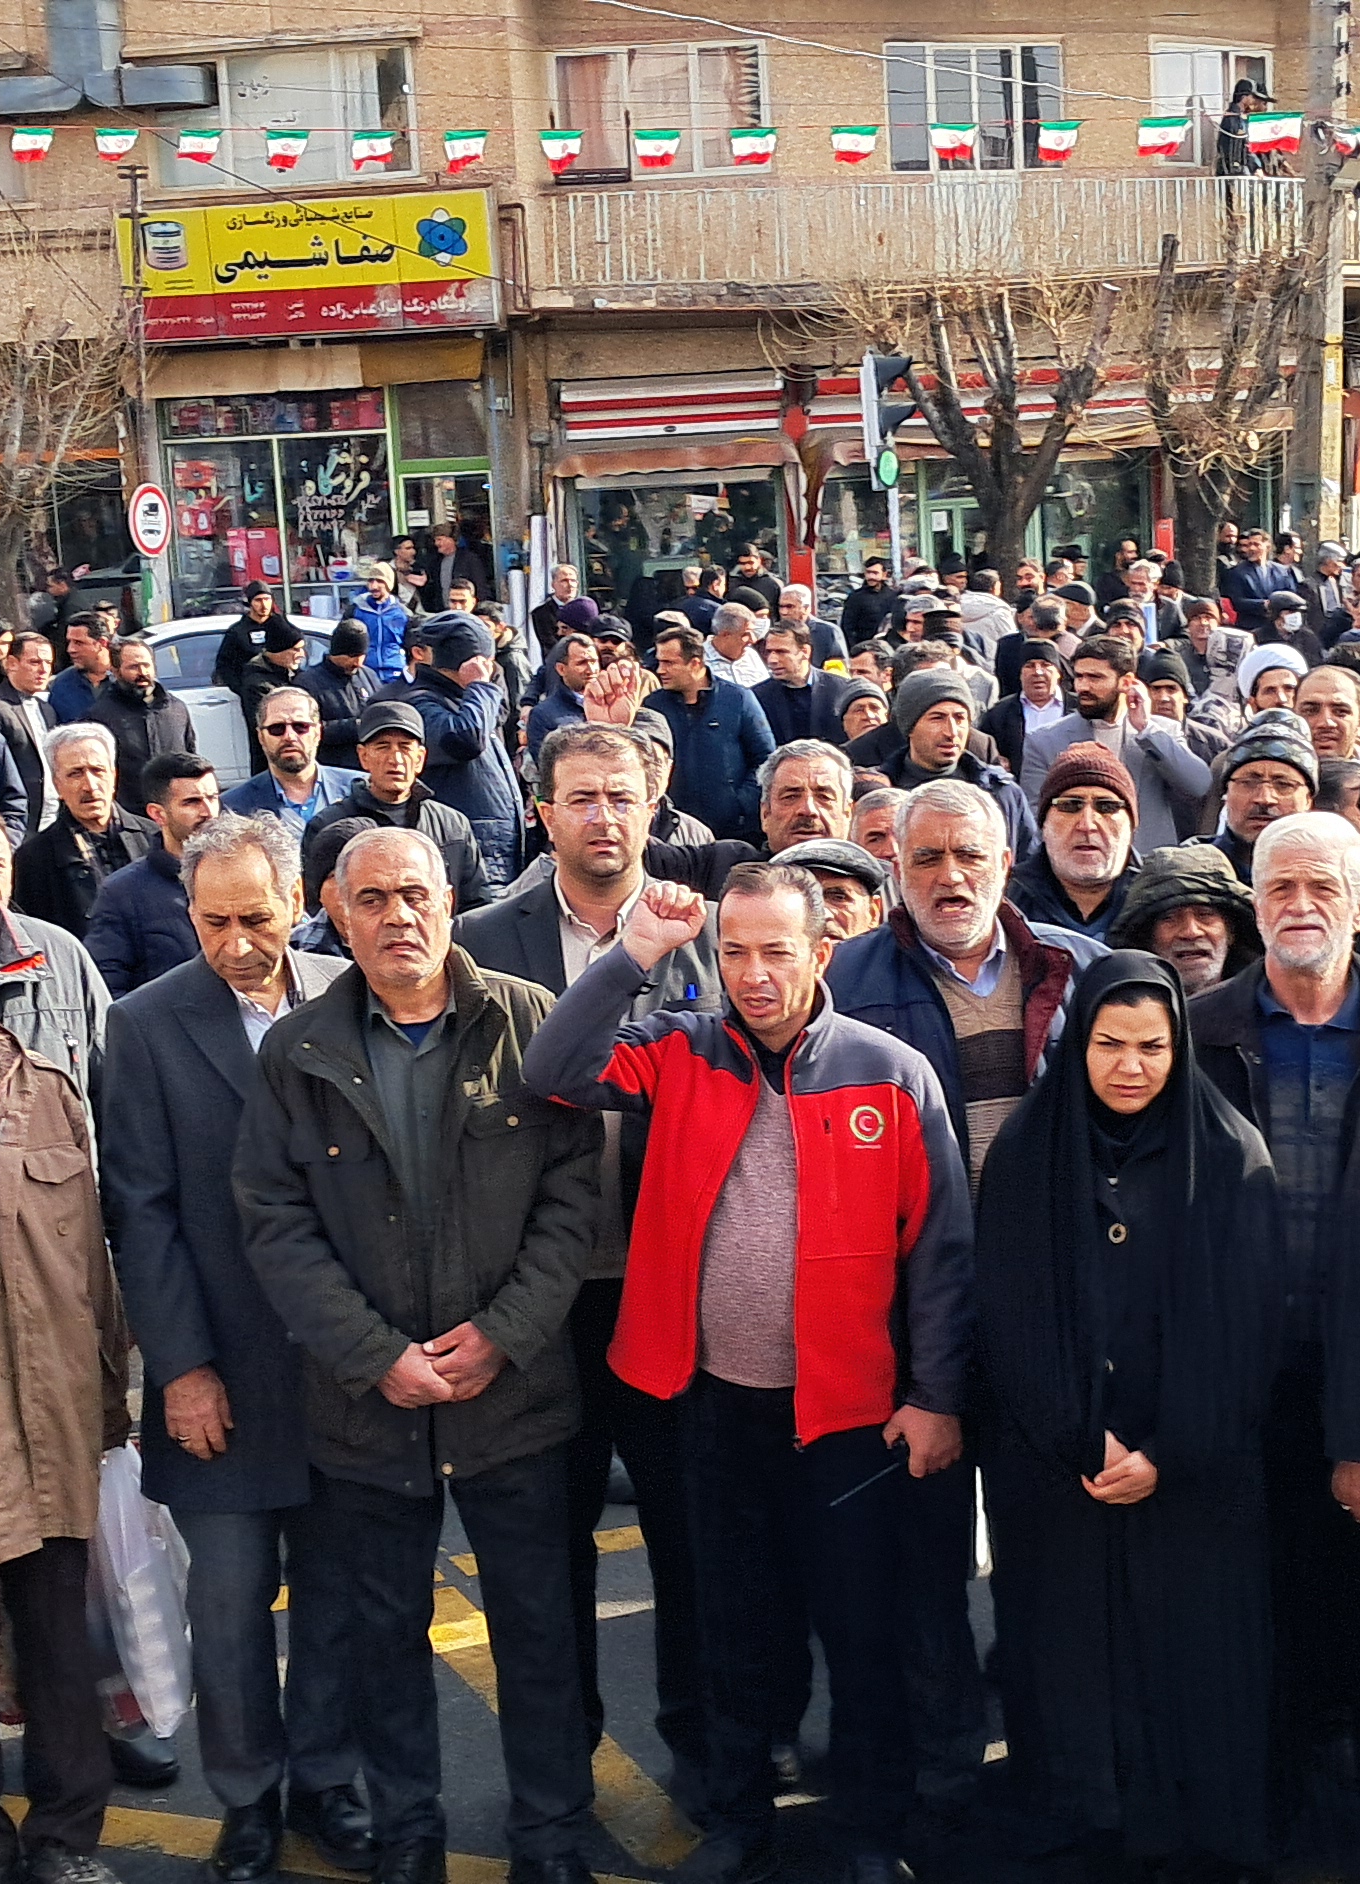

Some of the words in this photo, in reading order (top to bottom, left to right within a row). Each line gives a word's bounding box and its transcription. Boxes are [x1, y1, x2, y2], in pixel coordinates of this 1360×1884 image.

[341, 206, 374, 224] صنایع
[214, 234, 329, 284] شیمی
[334, 233, 397, 265] صفا
